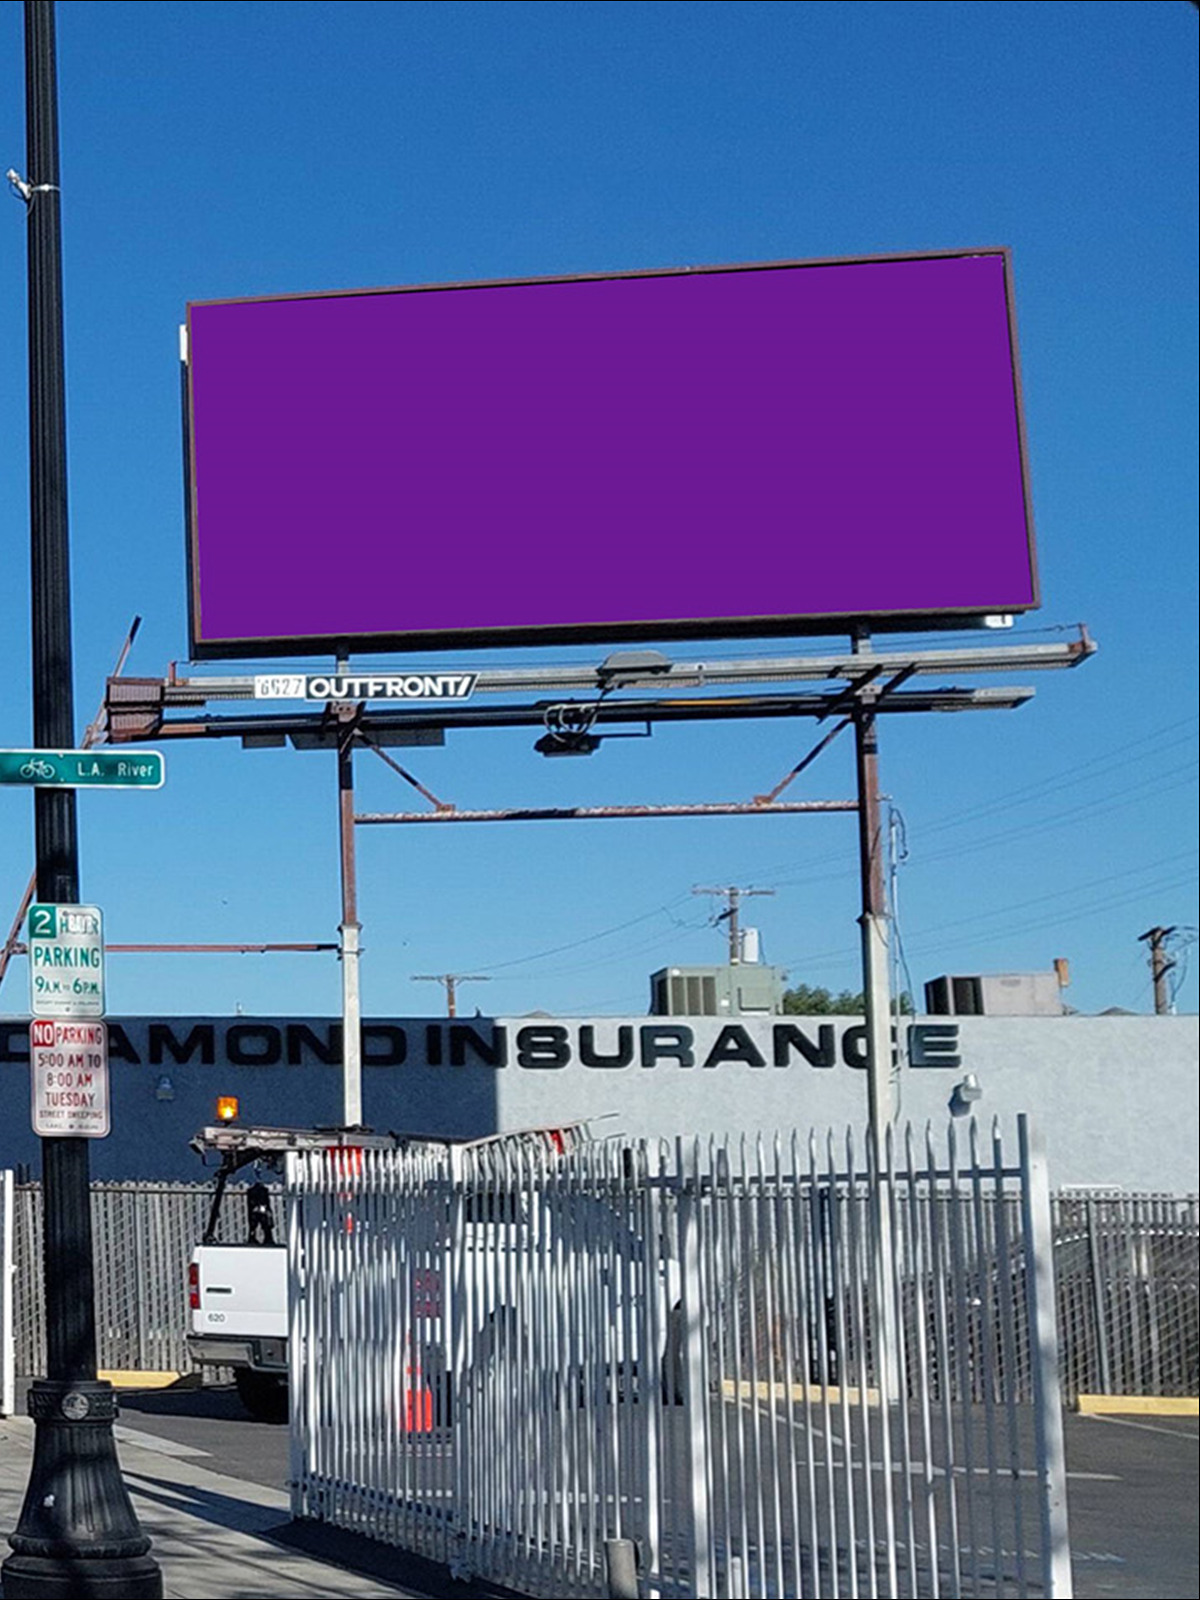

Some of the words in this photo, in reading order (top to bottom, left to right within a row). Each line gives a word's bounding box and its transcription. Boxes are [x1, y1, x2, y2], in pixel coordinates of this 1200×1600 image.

[77, 761, 106, 777] L.A.
[117, 761, 154, 777] River
[34, 909, 52, 934] 2
[60, 915, 100, 936] HR
[34, 946, 100, 968] PARKING
[33, 1023, 54, 1045] NO
[55, 1026, 103, 1045] PARKING
[426, 1023, 962, 1070] INSURANCE
[38, 1053, 64, 1068] 5:00
[68, 1053, 84, 1068] AM
[88, 1053, 102, 1068] TO
[47, 1072, 73, 1087] 8:00
[76, 1073, 93, 1088] AM
[44, 1091, 96, 1108] TUESDAY
[39, 1110, 65, 1119] STREET
[207, 1312, 226, 1323] 620
